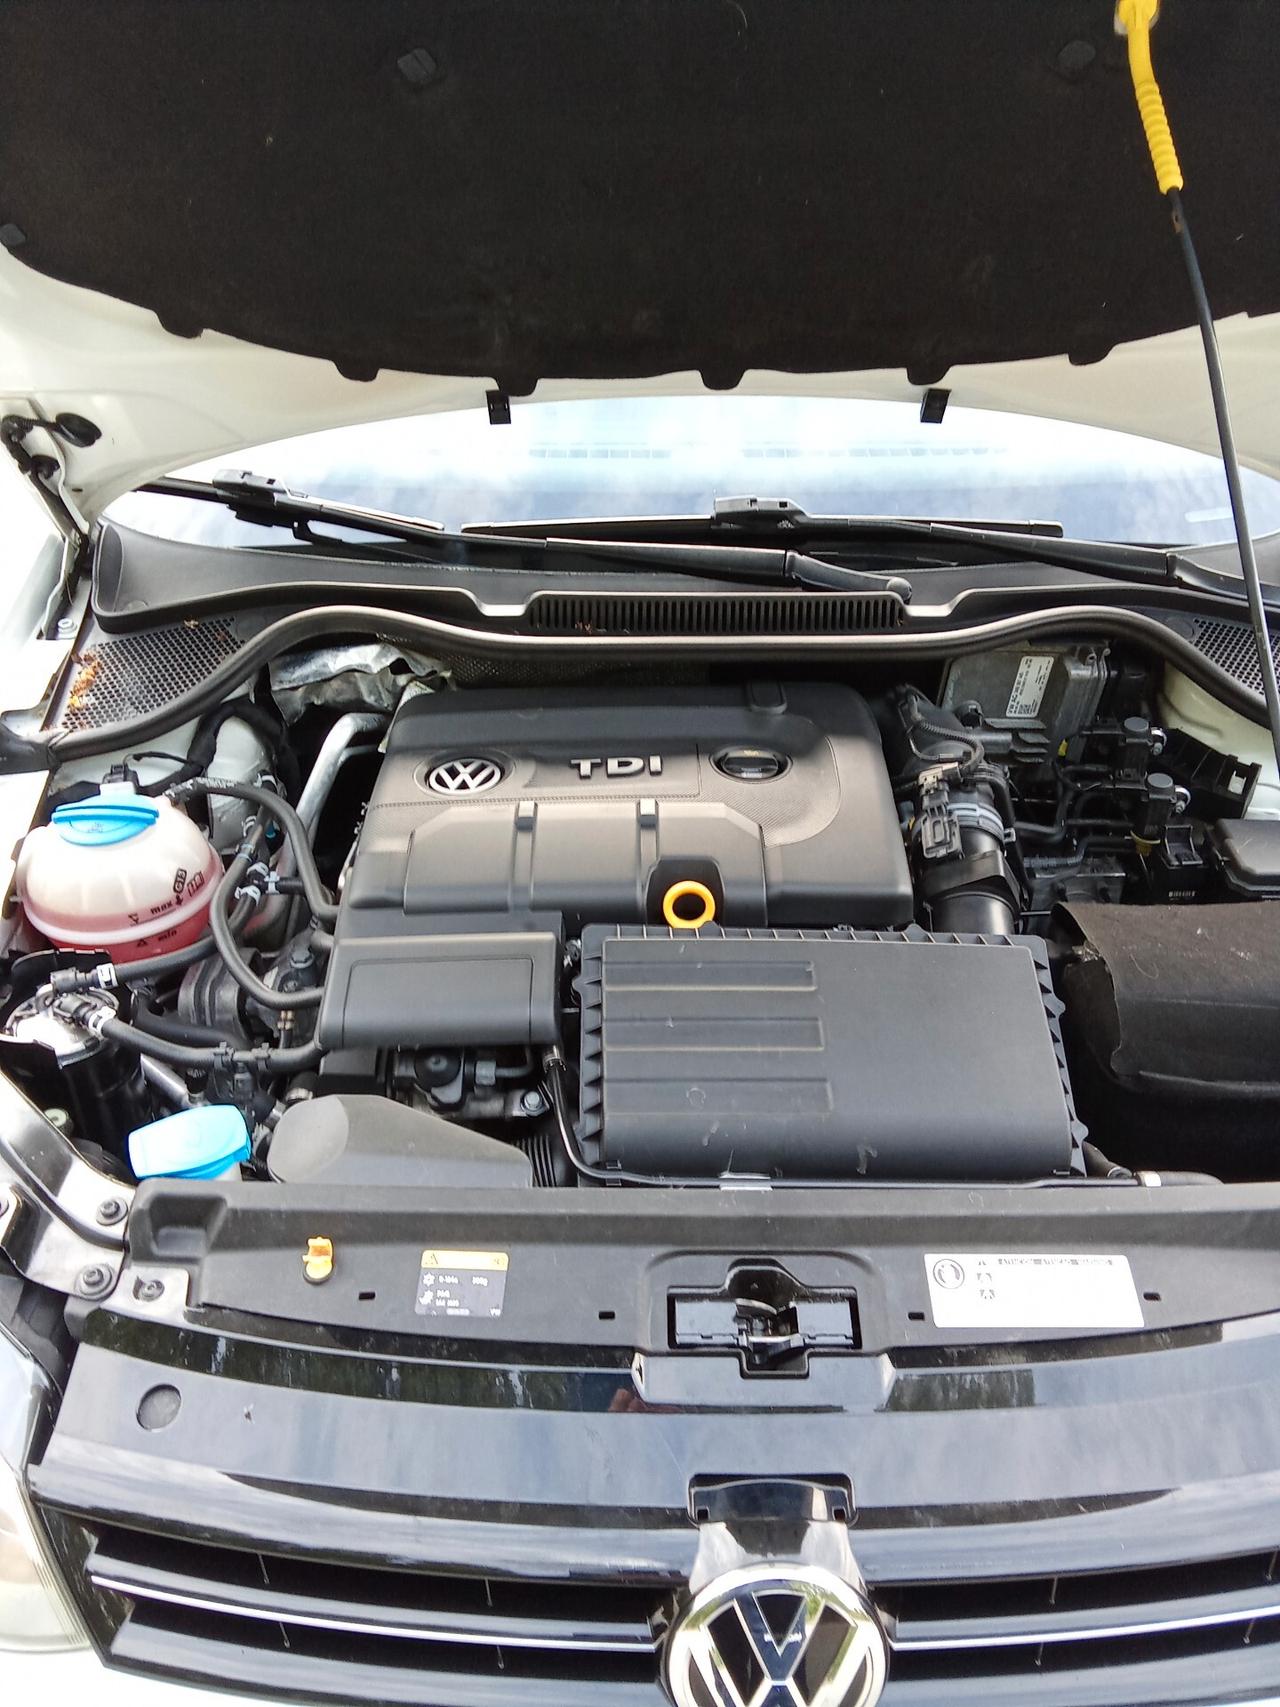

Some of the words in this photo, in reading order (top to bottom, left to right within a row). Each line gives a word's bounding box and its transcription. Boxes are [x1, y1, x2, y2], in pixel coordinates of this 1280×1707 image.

[429, 758, 501, 794] VW
[570, 755, 664, 781] TDI
[150, 901, 173, 914] max
[158, 930, 177, 941] min
